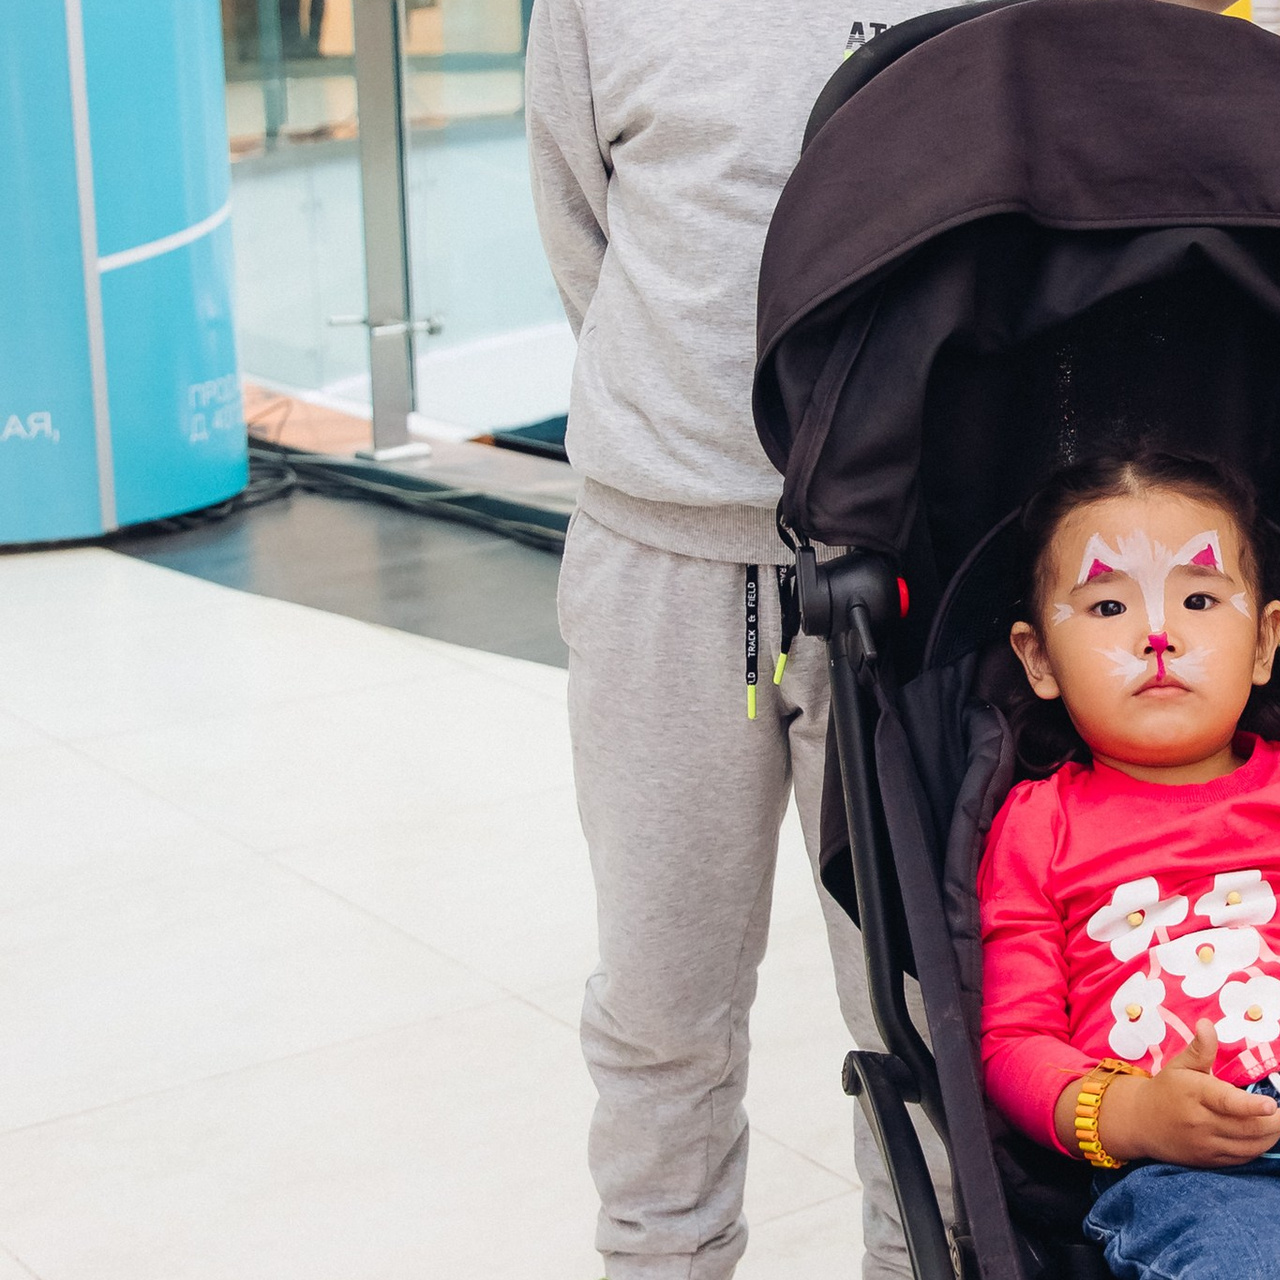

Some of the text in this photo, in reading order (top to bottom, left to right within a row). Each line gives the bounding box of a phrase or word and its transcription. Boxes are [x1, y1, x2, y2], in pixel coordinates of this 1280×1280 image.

[747, 581, 756, 608] FIELD
[747, 614, 756, 623] &
[747, 629, 756, 658] TRACK
